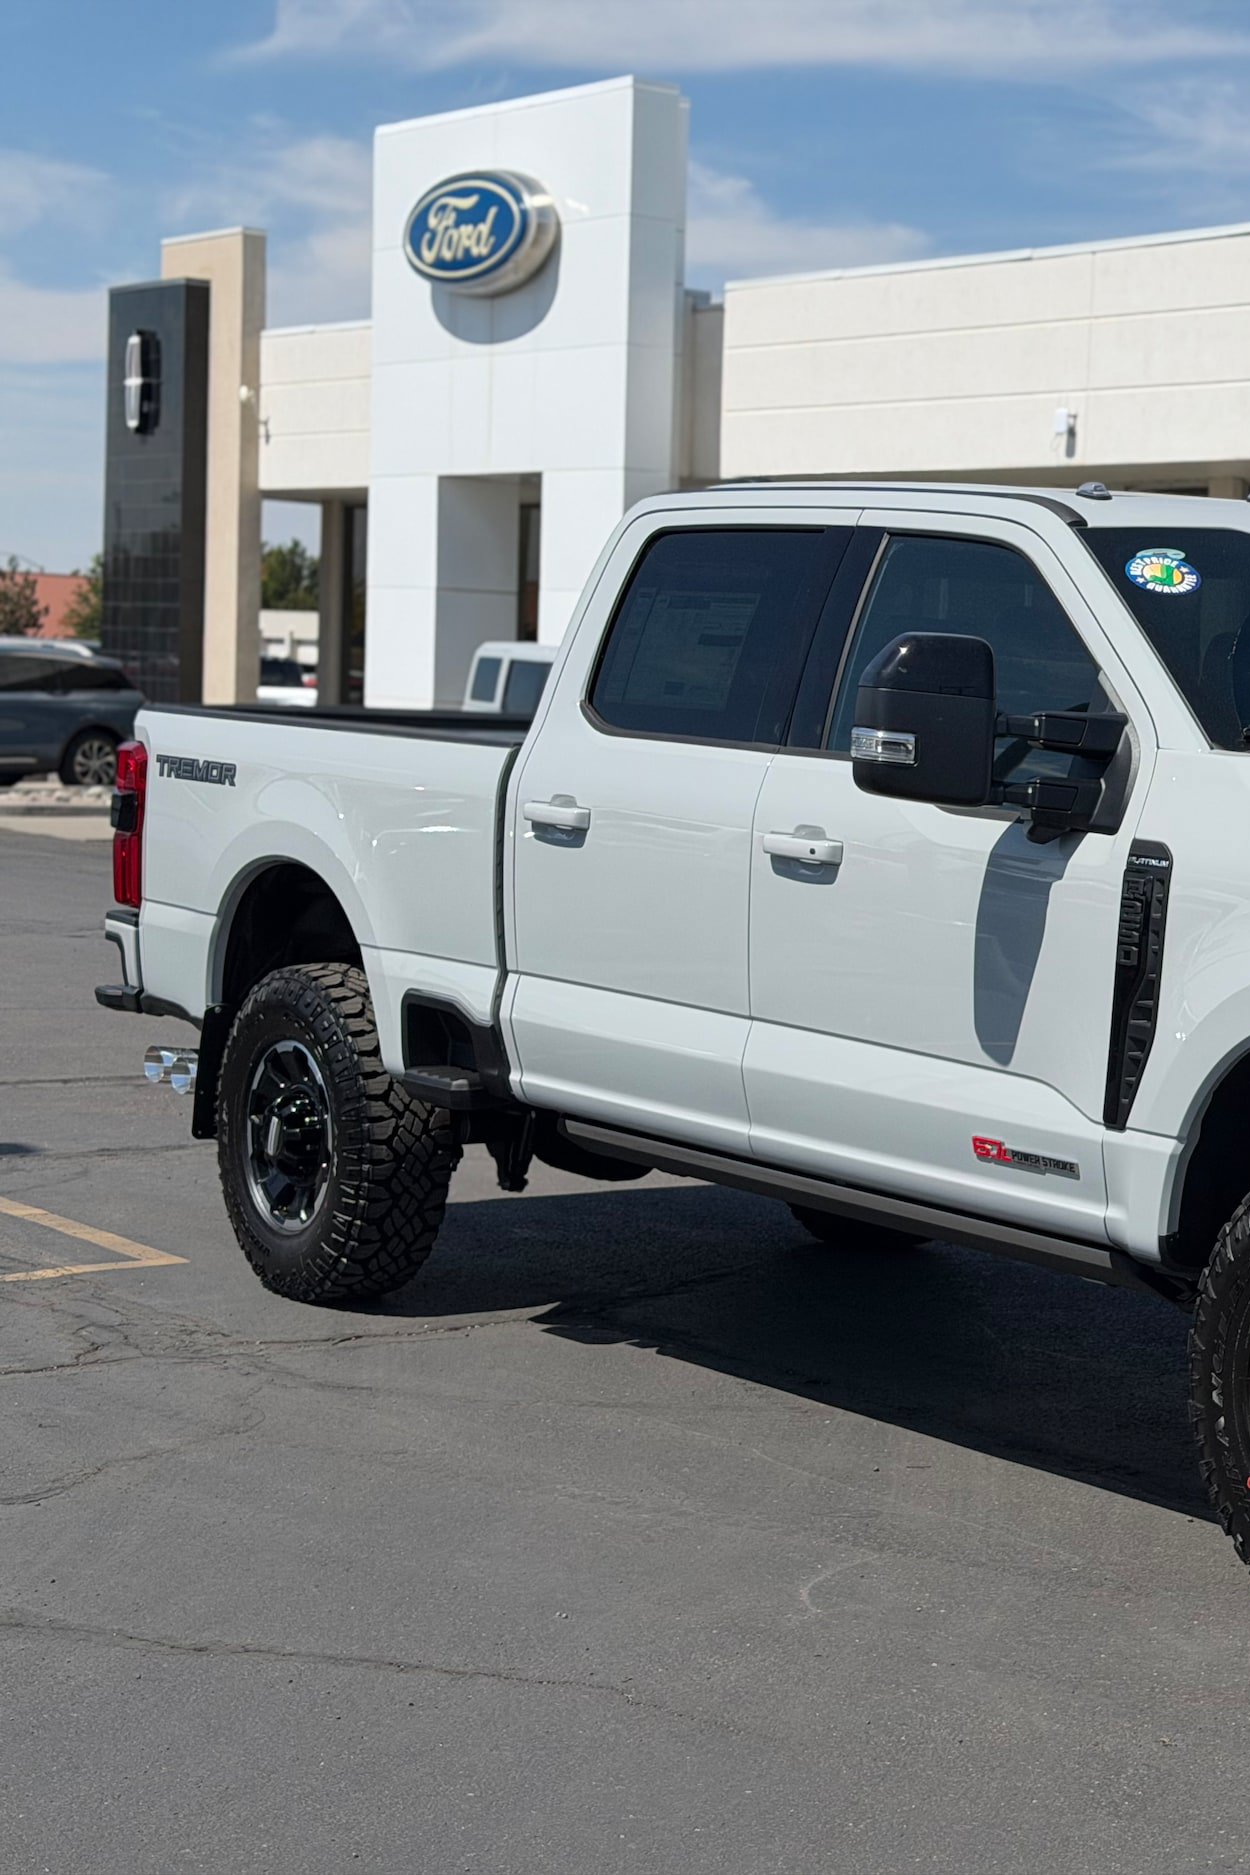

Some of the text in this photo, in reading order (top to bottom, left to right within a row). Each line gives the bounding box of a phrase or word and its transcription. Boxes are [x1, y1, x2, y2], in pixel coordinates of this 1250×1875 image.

[419, 193, 499, 266] Ford
[156, 753, 237, 787] TREMOR
[1128, 856, 1169, 868] PLATINUM
[1011, 1149, 1042, 1166] POWER
[1042, 1157, 1077, 1173] STROKE
